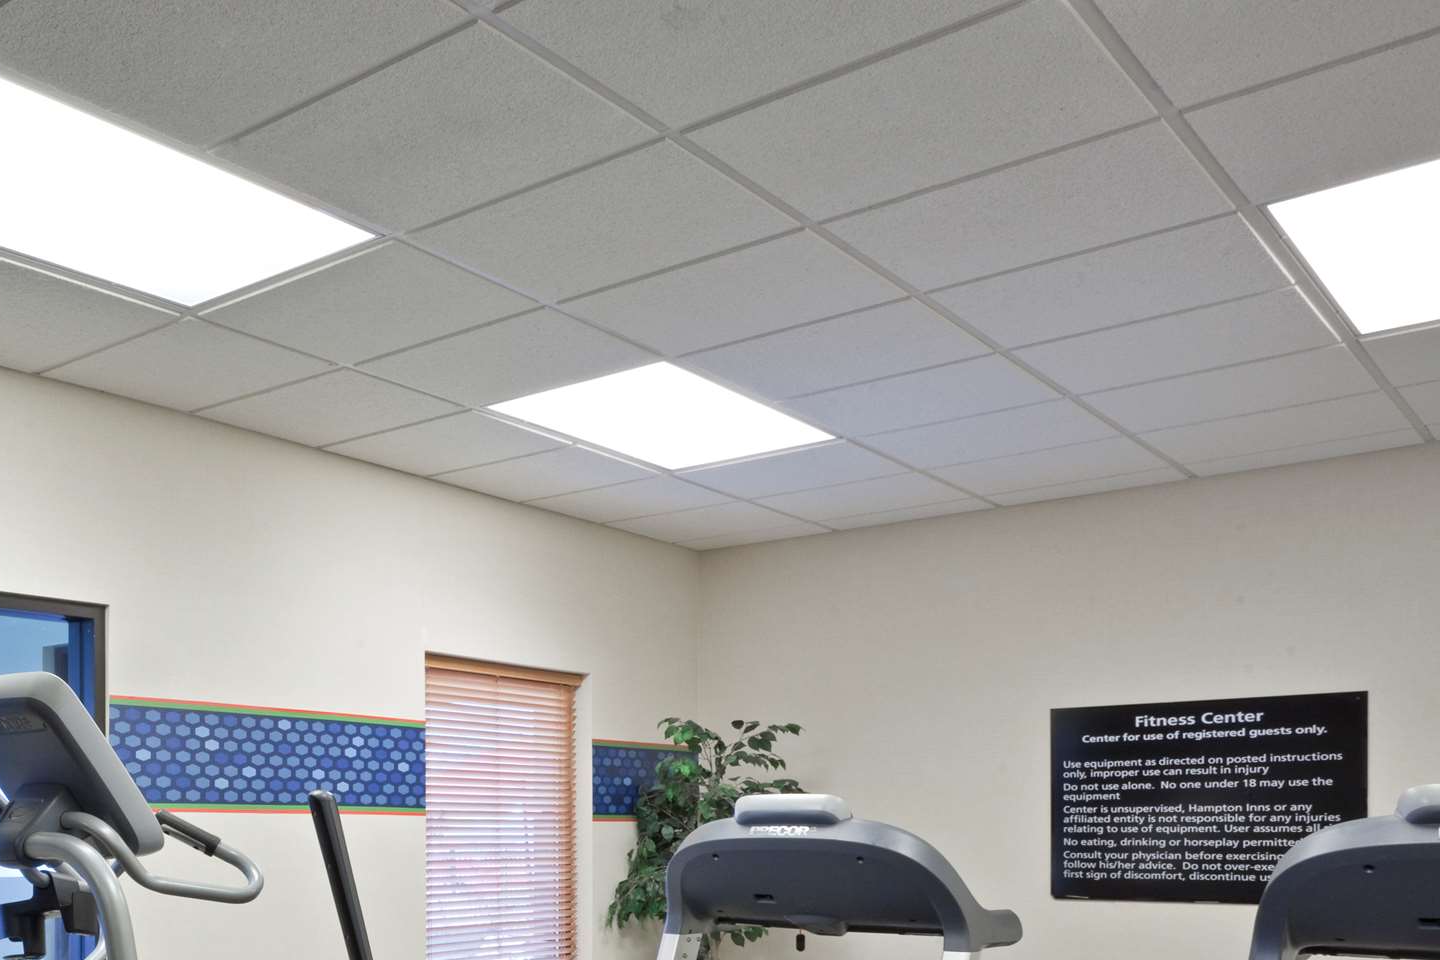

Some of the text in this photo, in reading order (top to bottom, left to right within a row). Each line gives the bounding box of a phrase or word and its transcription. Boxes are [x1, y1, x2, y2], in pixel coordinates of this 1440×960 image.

[1135, 711, 1264, 728] Fitness Center
[1082, 724, 1328, 744] Center for use of registered guests only.
[1063, 752, 1343, 771] Use equipment as directed on posted instructions
[1063, 764, 1270, 780] only, improper use can result in injury
[1063, 777, 1334, 792] Do not use alone. No one under 18 may use the
[1063, 792, 1121, 802] equipment
[1063, 803, 1313, 815] Center is unsupervised, Hampton Inns or any
[1063, 813, 1342, 825] affiliated entity is not responsible for any injuries
[1063, 824, 1104, 835] relating
[1106, 825, 1118, 833] to
[1121, 825, 1139, 833] use
[1141, 824, 1154, 833] of
[1156, 824, 1221, 835] equipment.
[1224, 824, 1250, 833] User
[1253, 825, 1303, 833] assumes
[1305, 823, 1321, 833] all
[1063, 838, 1078, 846] No
[1080, 838, 1117, 848] eating,
[1120, 837, 1166, 848] drinking
[1168, 839, 1181, 847] or
[1184, 837, 1240, 848] horseplay
[1063, 850, 1102, 859] Consult
[1104, 851, 1129, 861] your
[1131, 851, 1182, 862] physician
[1185, 851, 1223, 861] before
[1063, 860, 1097, 869] follow
[1099, 860, 1136, 869] his/her
[1138, 861, 1177, 870] advice.
[1182, 862, 1199, 870] Do
[1201, 862, 1222, 871] not
[1063, 870, 1084, 879] first
[1085, 870, 1107, 881] sign
[1109, 870, 1122, 880] of
[1123, 870, 1186, 882] discomfort,
[1188, 871, 1257, 882] discontinue
